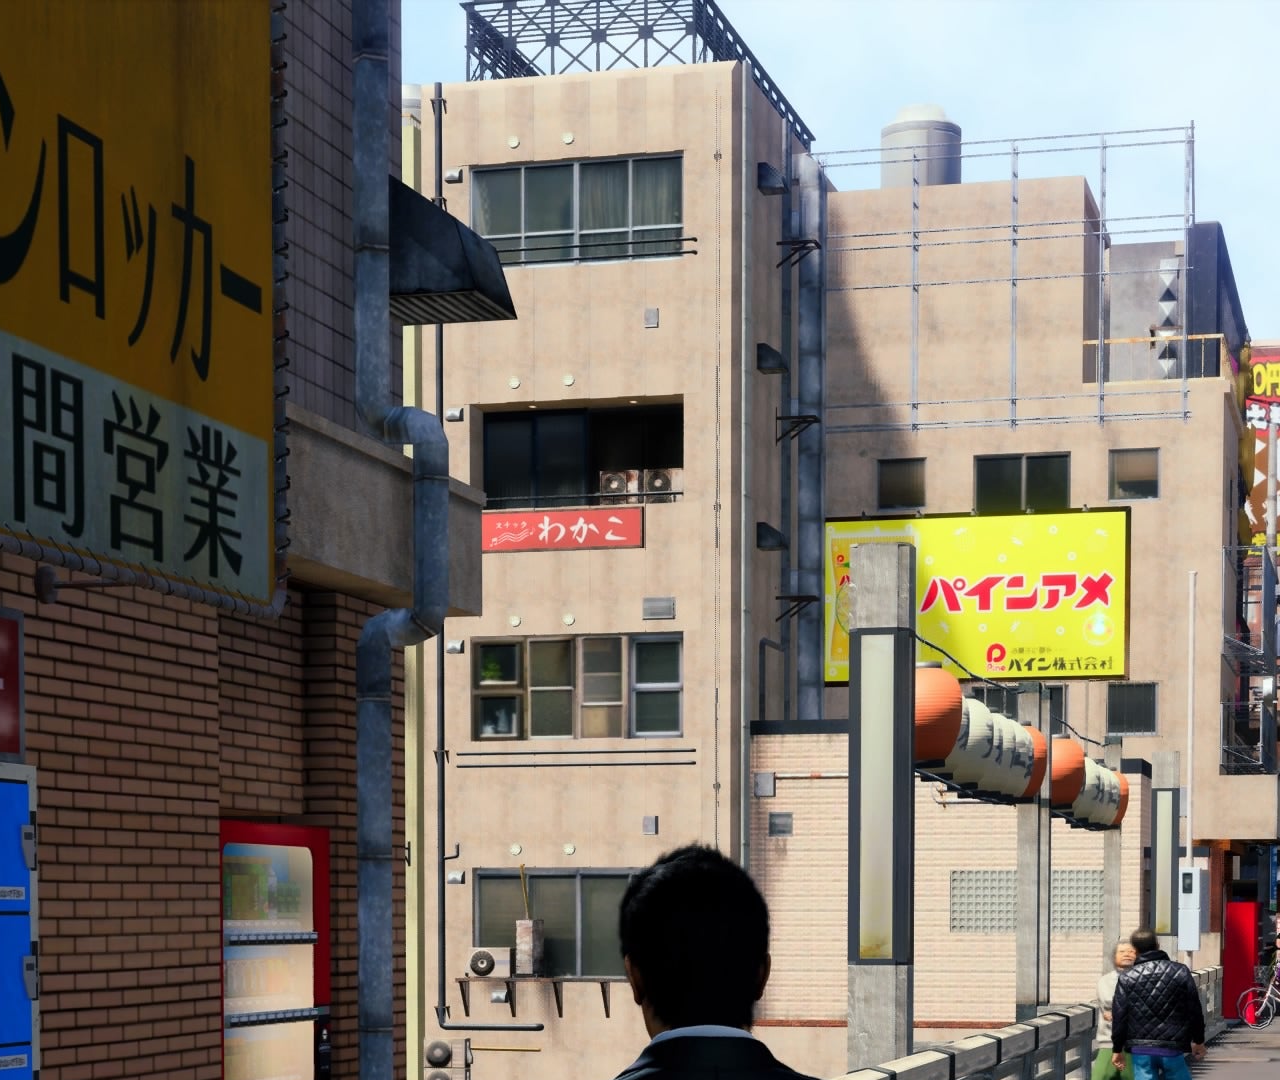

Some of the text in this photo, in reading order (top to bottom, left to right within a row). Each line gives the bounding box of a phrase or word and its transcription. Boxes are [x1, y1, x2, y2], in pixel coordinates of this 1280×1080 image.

[538, 515, 628, 545] わかこ
[920, 572, 1114, 613] パインアメ
[1008, 656, 1113, 672] パイン株式会社
